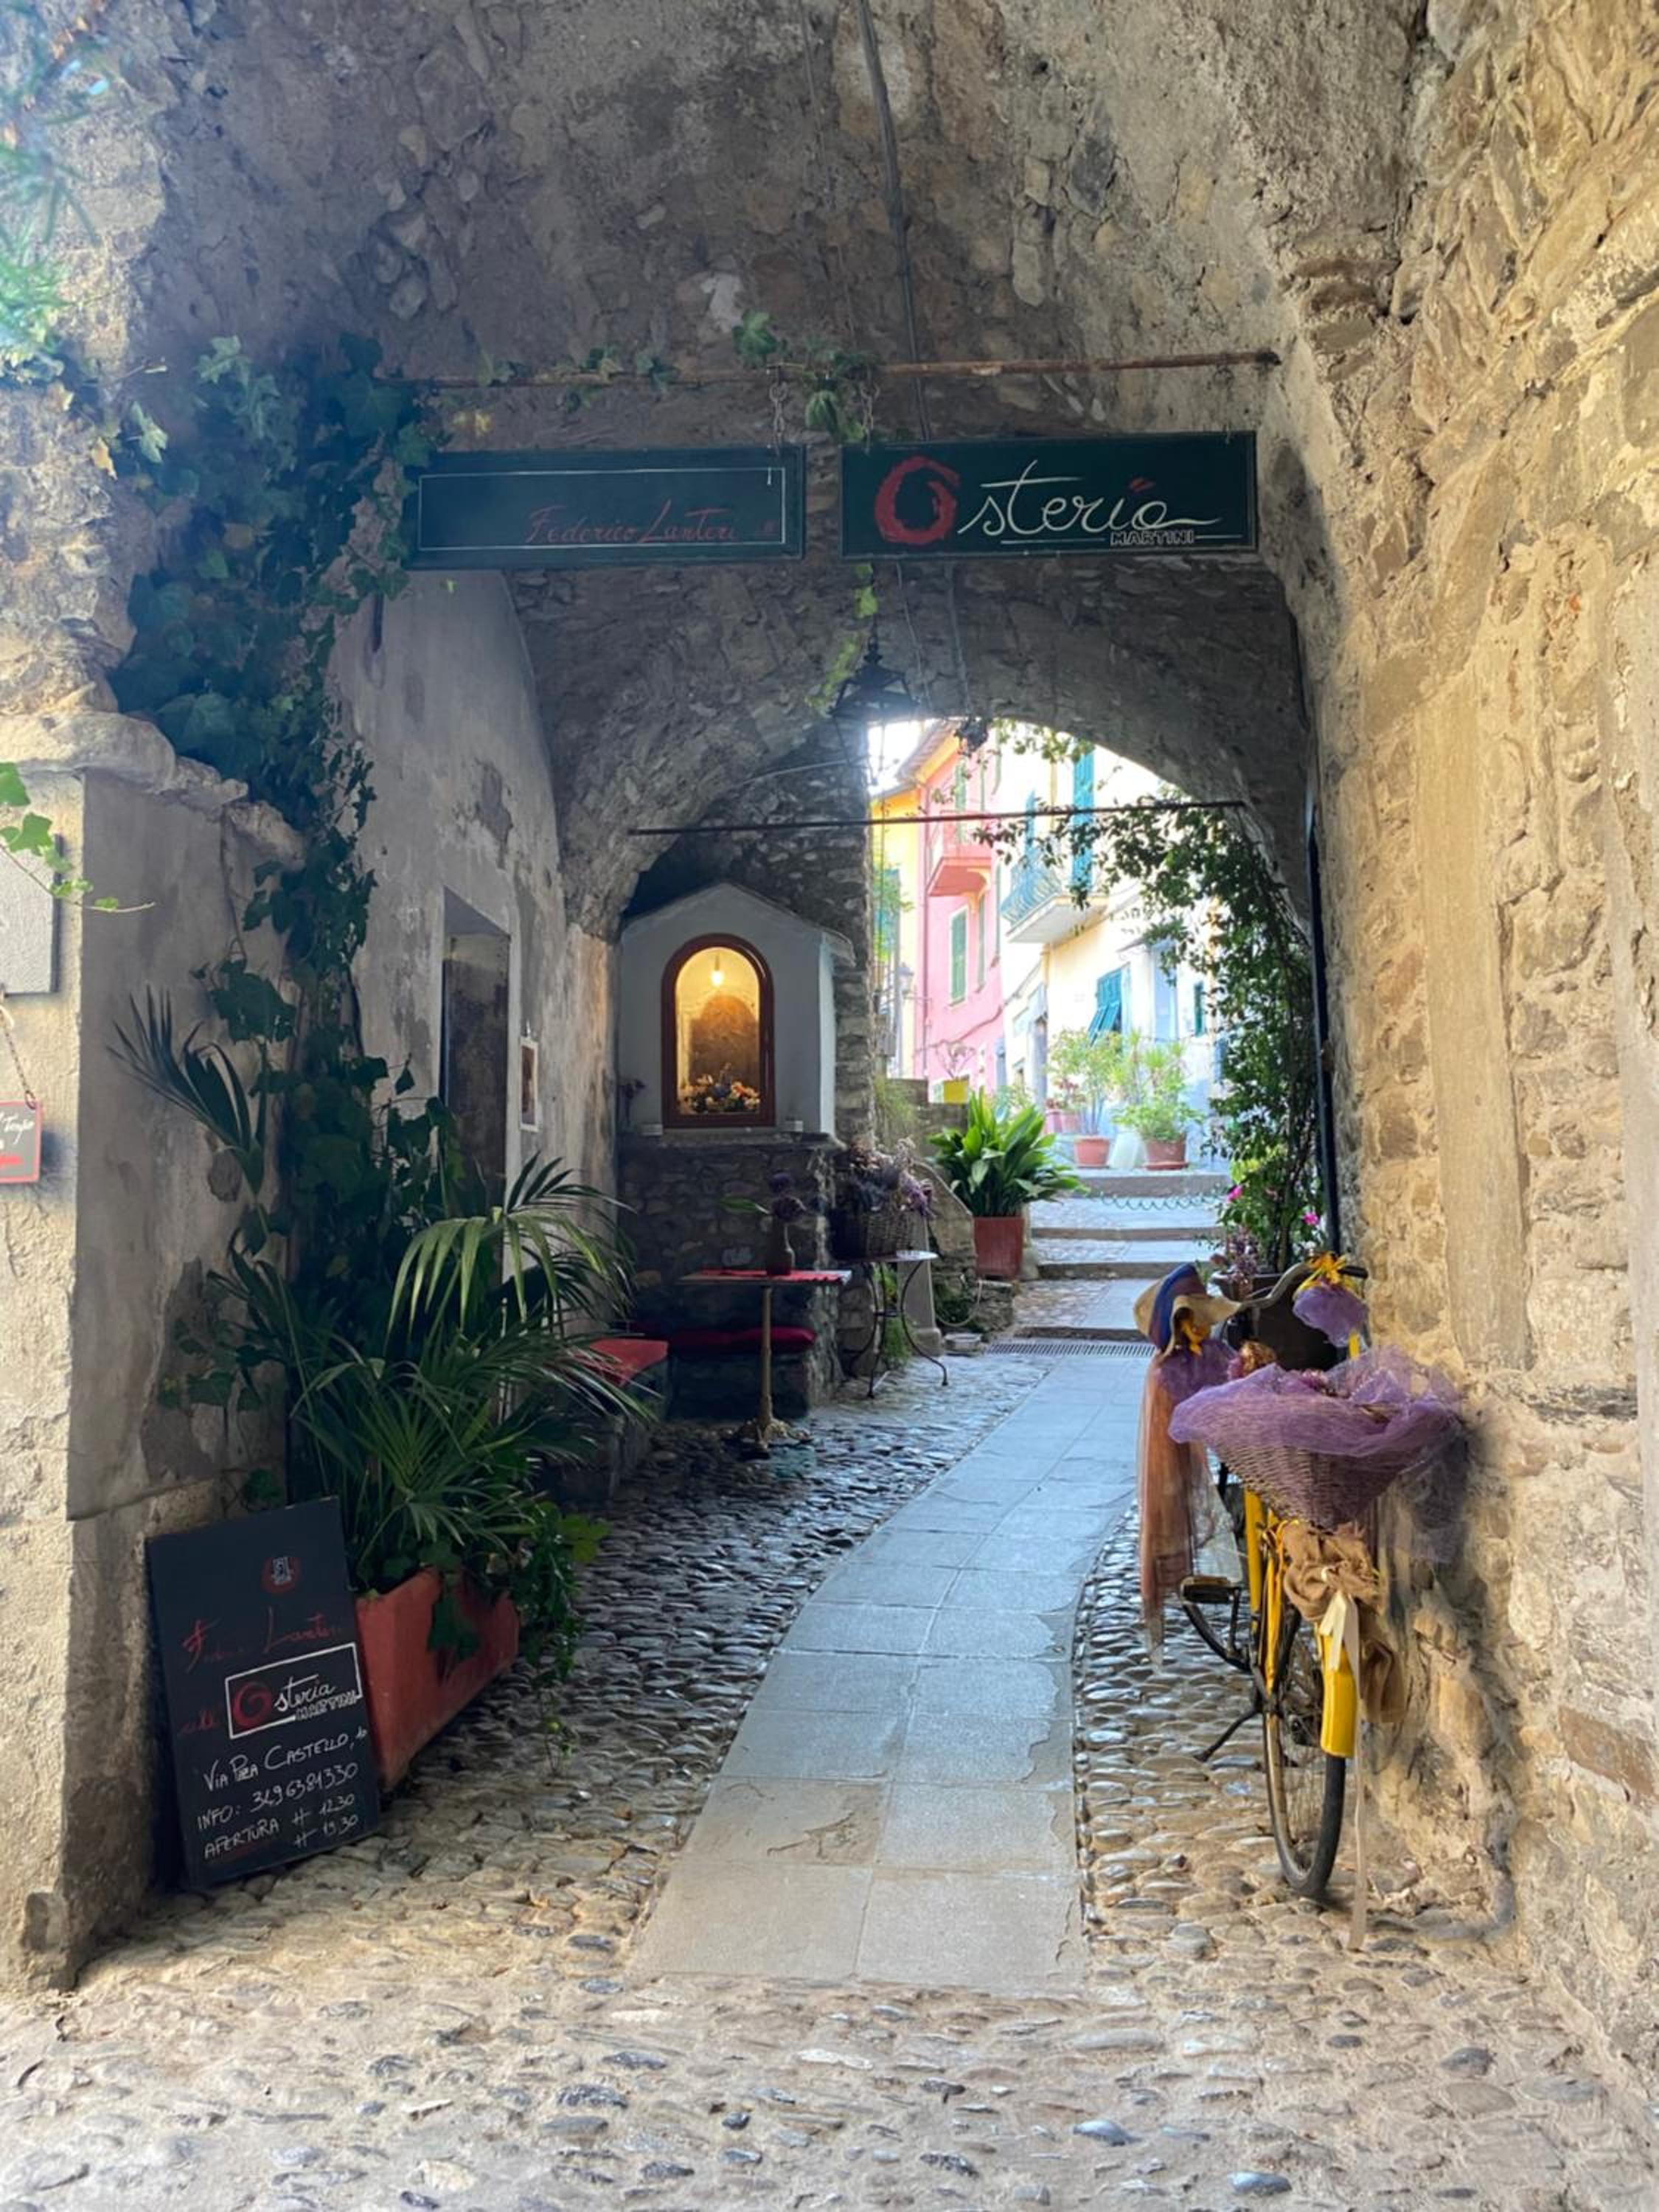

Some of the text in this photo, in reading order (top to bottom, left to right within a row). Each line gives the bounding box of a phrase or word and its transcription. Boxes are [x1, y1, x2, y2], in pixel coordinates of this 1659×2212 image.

[874, 456, 1222, 545] Osteria
[1110, 529, 1196, 546] MARTINI
[232, 1674, 336, 1727] Osteria
[198, 1806, 241, 1829] INFO:
[204, 1818, 280, 1860] APERTURA
